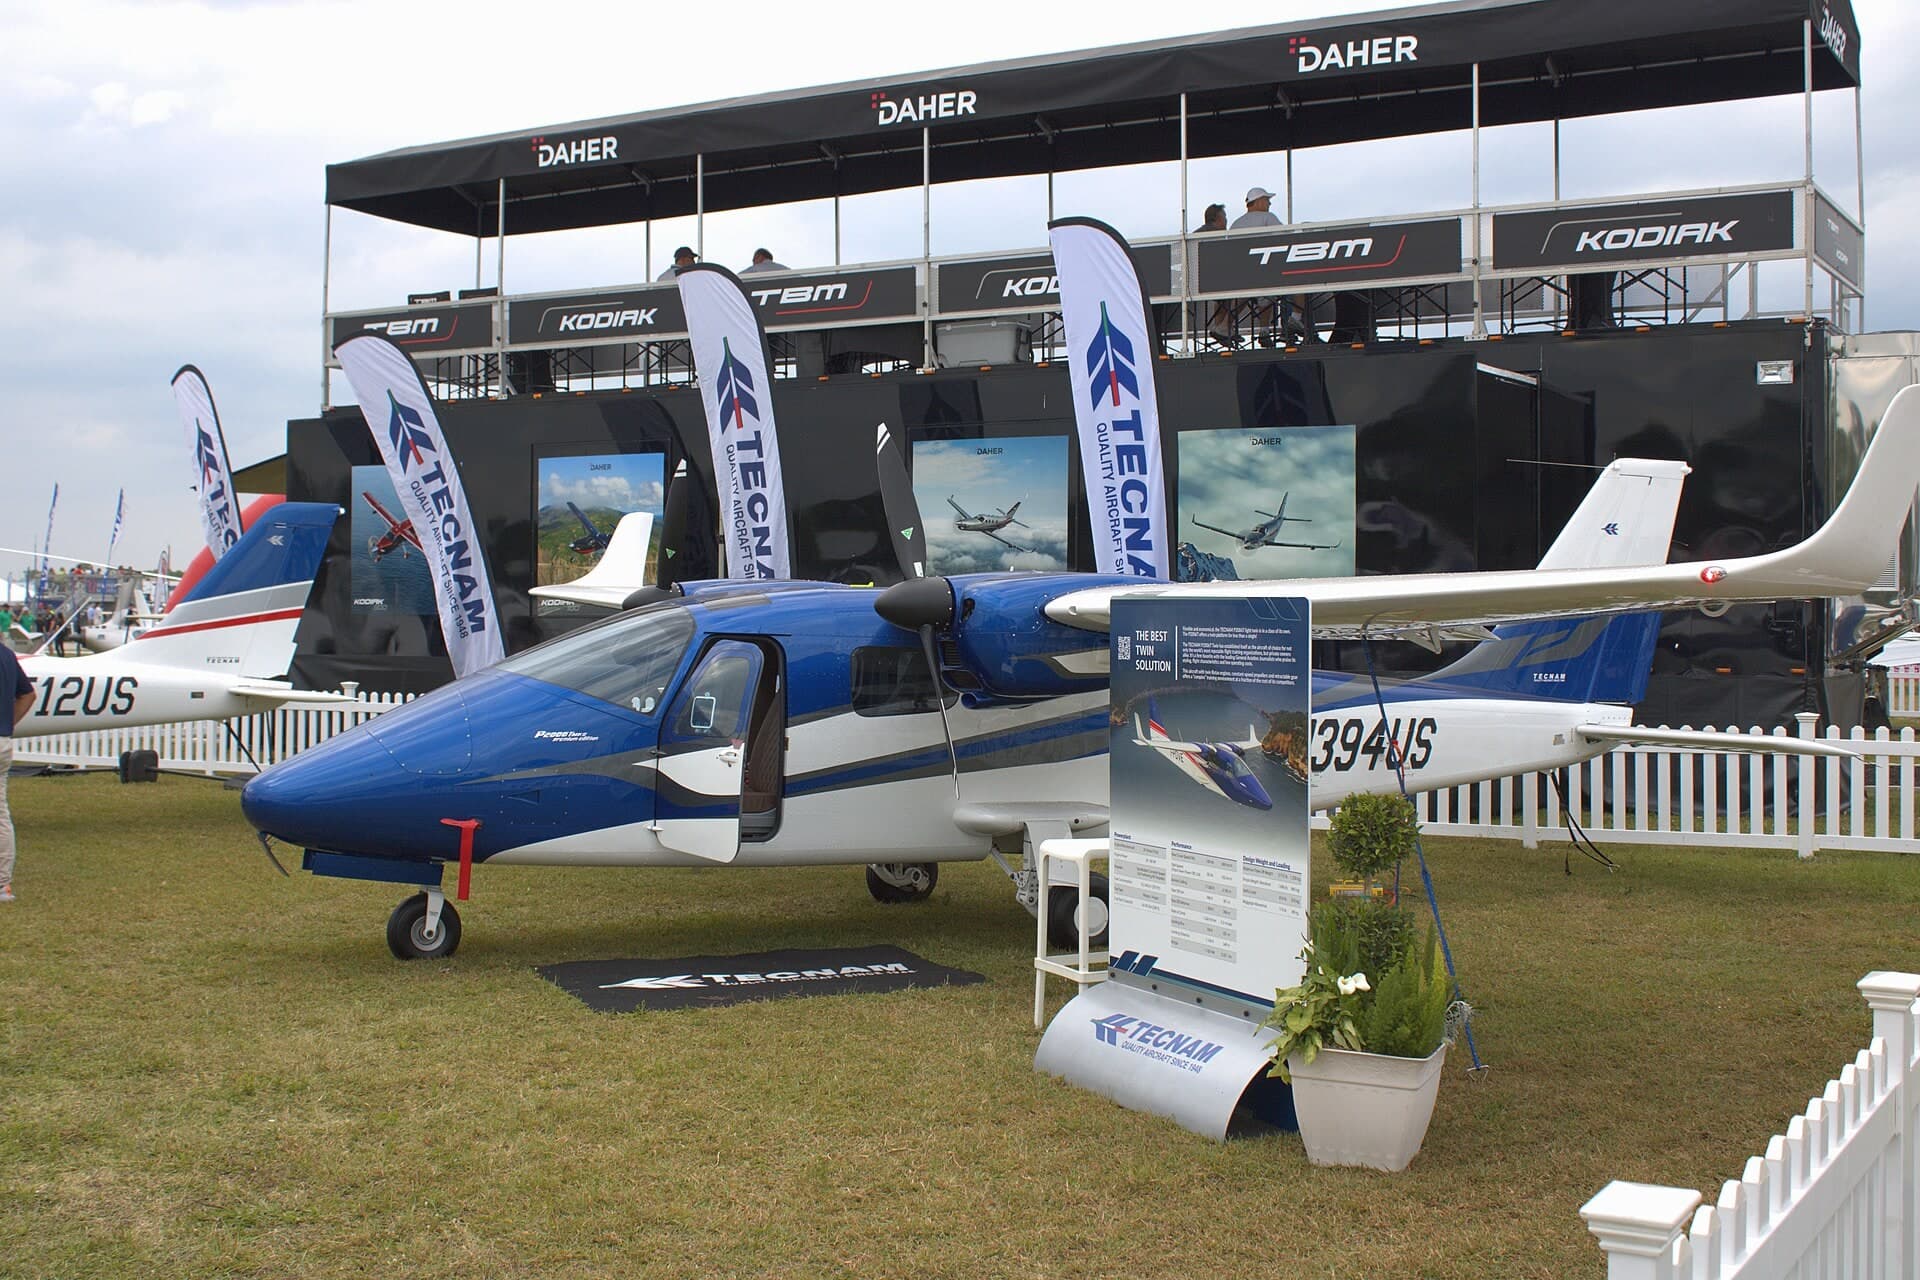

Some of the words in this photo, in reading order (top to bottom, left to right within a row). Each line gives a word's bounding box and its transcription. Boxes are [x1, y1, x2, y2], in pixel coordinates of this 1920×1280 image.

[1298, 35, 1418, 73] DAHER
[878, 90, 977, 125] DAHER
[538, 136, 618, 167] DAHER
[1249, 237, 1373, 265] TBM
[1575, 220, 1740, 252] KODIAK
[751, 283, 848, 306] TBM
[1002, 276, 1062, 297] KOD
[559, 307, 658, 332] KODIAK
[977, 447, 1003, 455] DAHER
[1096, 422, 1115, 481] QUALITY
[1252, 437, 1282, 446] DAHER
[726, 444, 740, 495] QUALITY
[733, 499, 752, 560] AIRCRAFT
[736, 430, 775, 579] TECNA
[1111, 409, 1157, 577] TECNA
[209, 480, 238, 546] TEC
[1104, 485, 1123, 554] AIRCRAFT
[410, 480, 437, 525] QUALITY
[455, 615, 469, 639] 1948
[422, 461, 486, 633] TECNAM
[1136, 630, 1149, 641] THE
[1151, 631, 1168, 642] BEST
[1136, 645, 1154, 656] TWIN
[1136, 660, 1171, 672] SOLUTION
[29, 676, 138, 716] 12US
[702, 963, 909, 983] TECNAM
[1121, 1040, 1144, 1056] QUALITY
[1143, 1049, 1172, 1064] AIRCRAFT
[1171, 1056, 1190, 1070] SINCE
[1128, 1021, 1224, 1063] TECNAM
